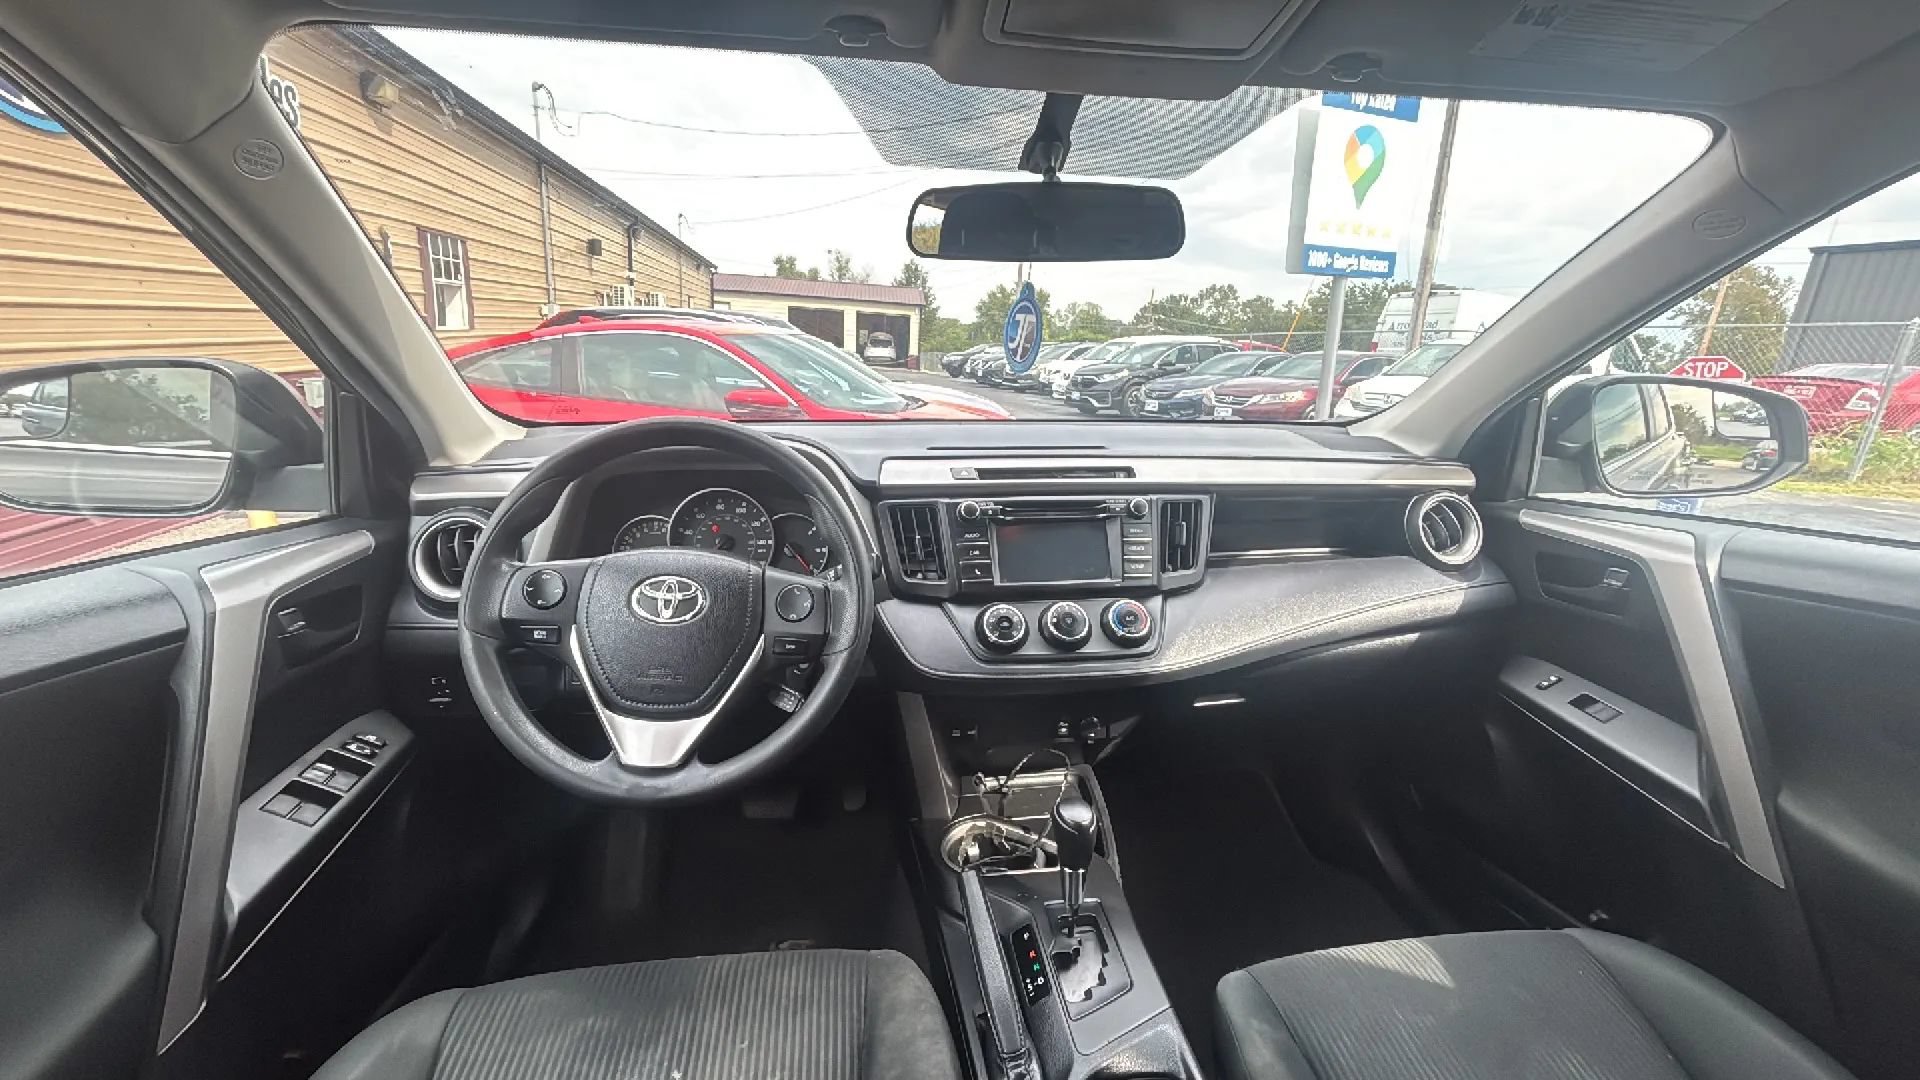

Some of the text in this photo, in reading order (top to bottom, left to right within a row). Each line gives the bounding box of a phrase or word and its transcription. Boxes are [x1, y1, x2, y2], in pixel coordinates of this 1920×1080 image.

[1308, 249, 1389, 273] 1000+ Google Reviews
[1682, 361, 1729, 377] STOP
